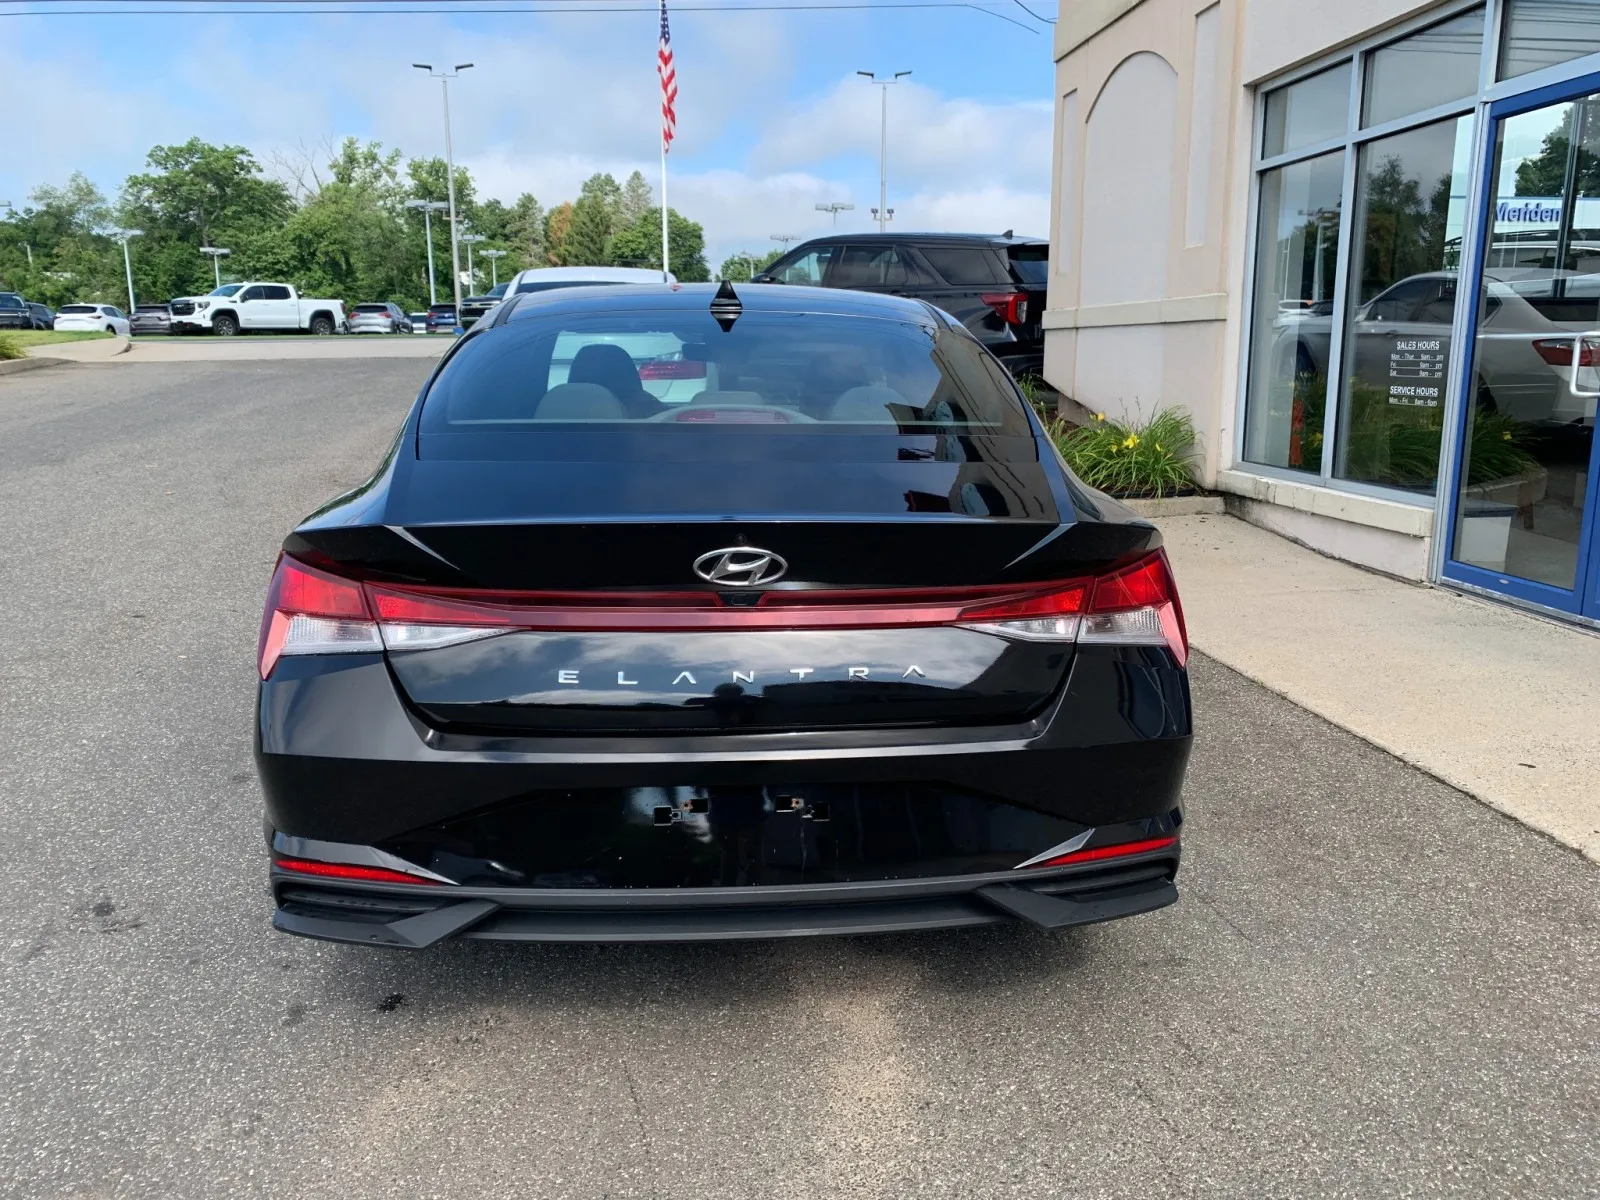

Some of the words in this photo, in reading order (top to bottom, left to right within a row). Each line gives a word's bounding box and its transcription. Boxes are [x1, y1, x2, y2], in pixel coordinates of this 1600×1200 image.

[1496, 202, 1561, 222] Meriden
[1396, 341, 1416, 350] SALES
[1417, 341, 1440, 350] HOURS
[1389, 385, 1415, 395] SERVICE
[1415, 386, 1439, 397] HOURS
[557, 664, 926, 686] ELANTRA
